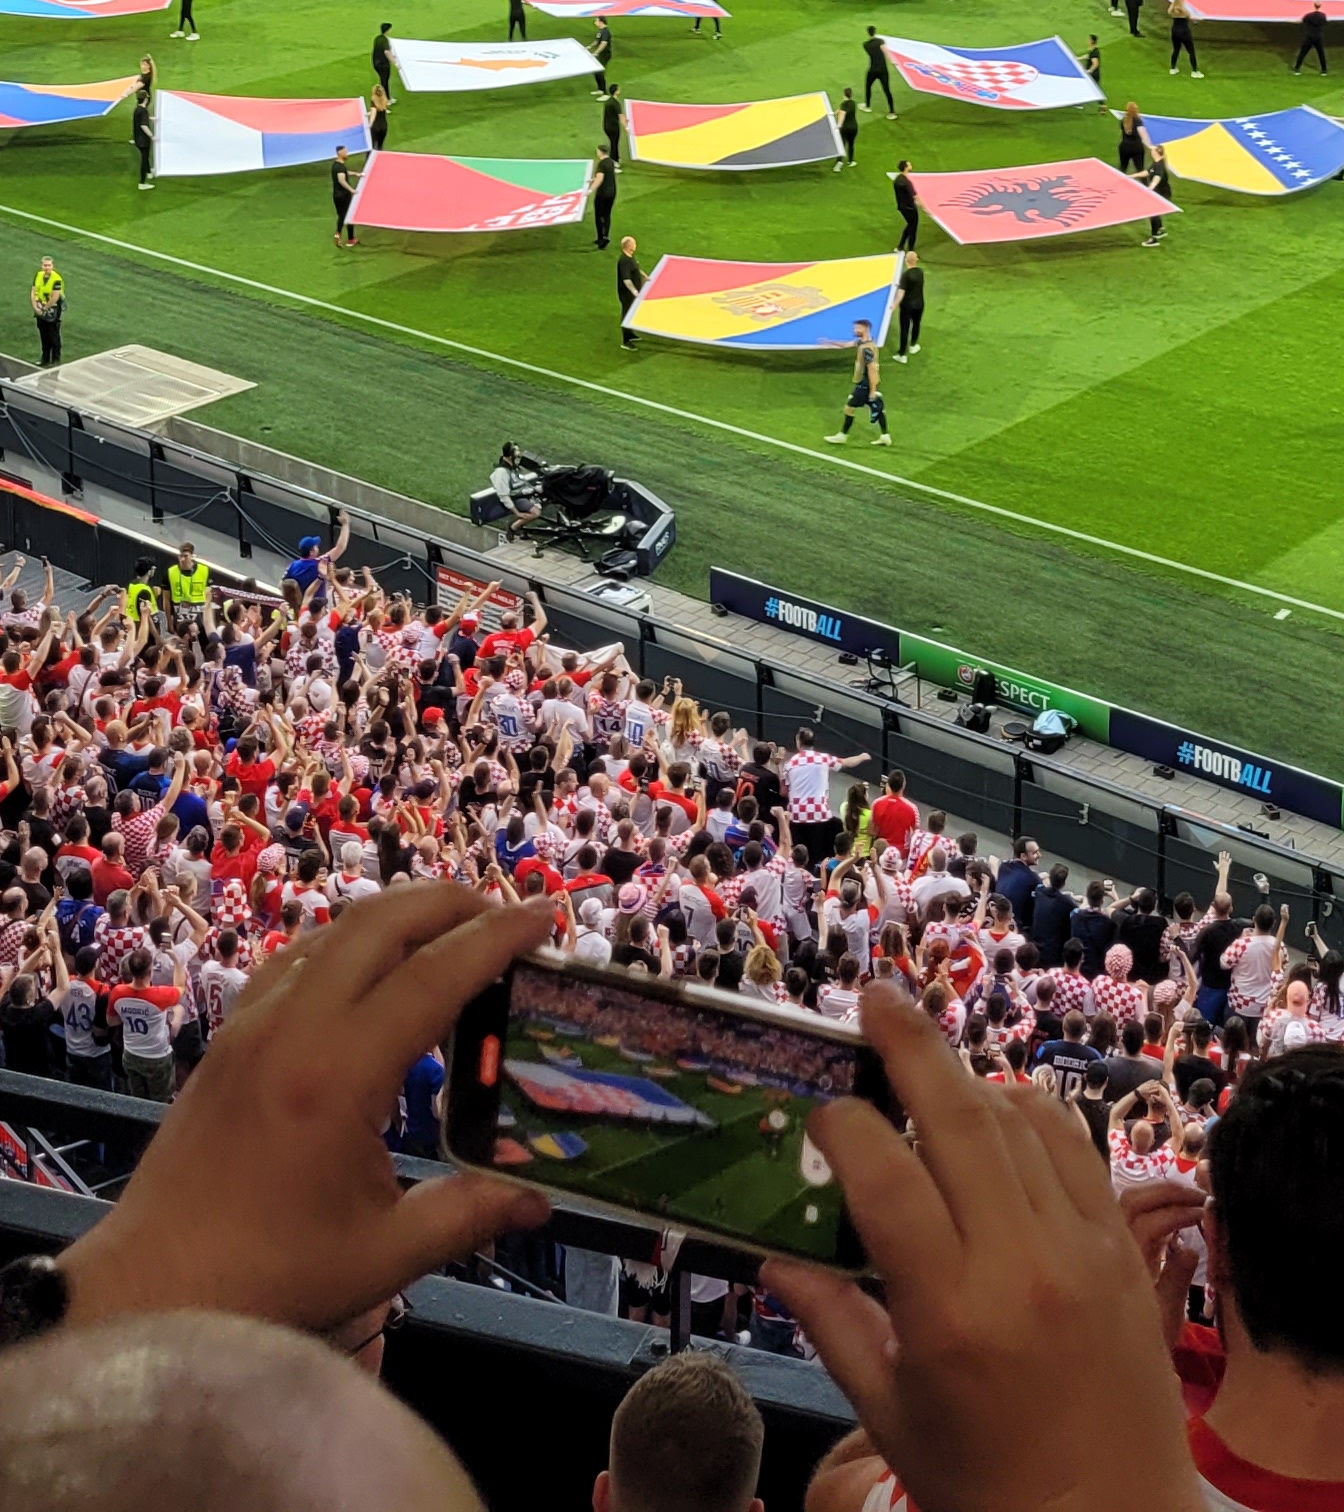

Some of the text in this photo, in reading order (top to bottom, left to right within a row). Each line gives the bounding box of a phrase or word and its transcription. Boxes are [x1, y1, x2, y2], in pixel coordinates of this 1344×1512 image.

[764, 596, 843, 642] #FOOTBALL
[994, 678, 1051, 711] ESPECT
[599, 718, 621, 732] 14
[1176, 740, 1273, 795] #FOOTBALL
[683, 905, 694, 928] 7
[66, 1002, 93, 1032] 43
[126, 1016, 149, 1036] 10
